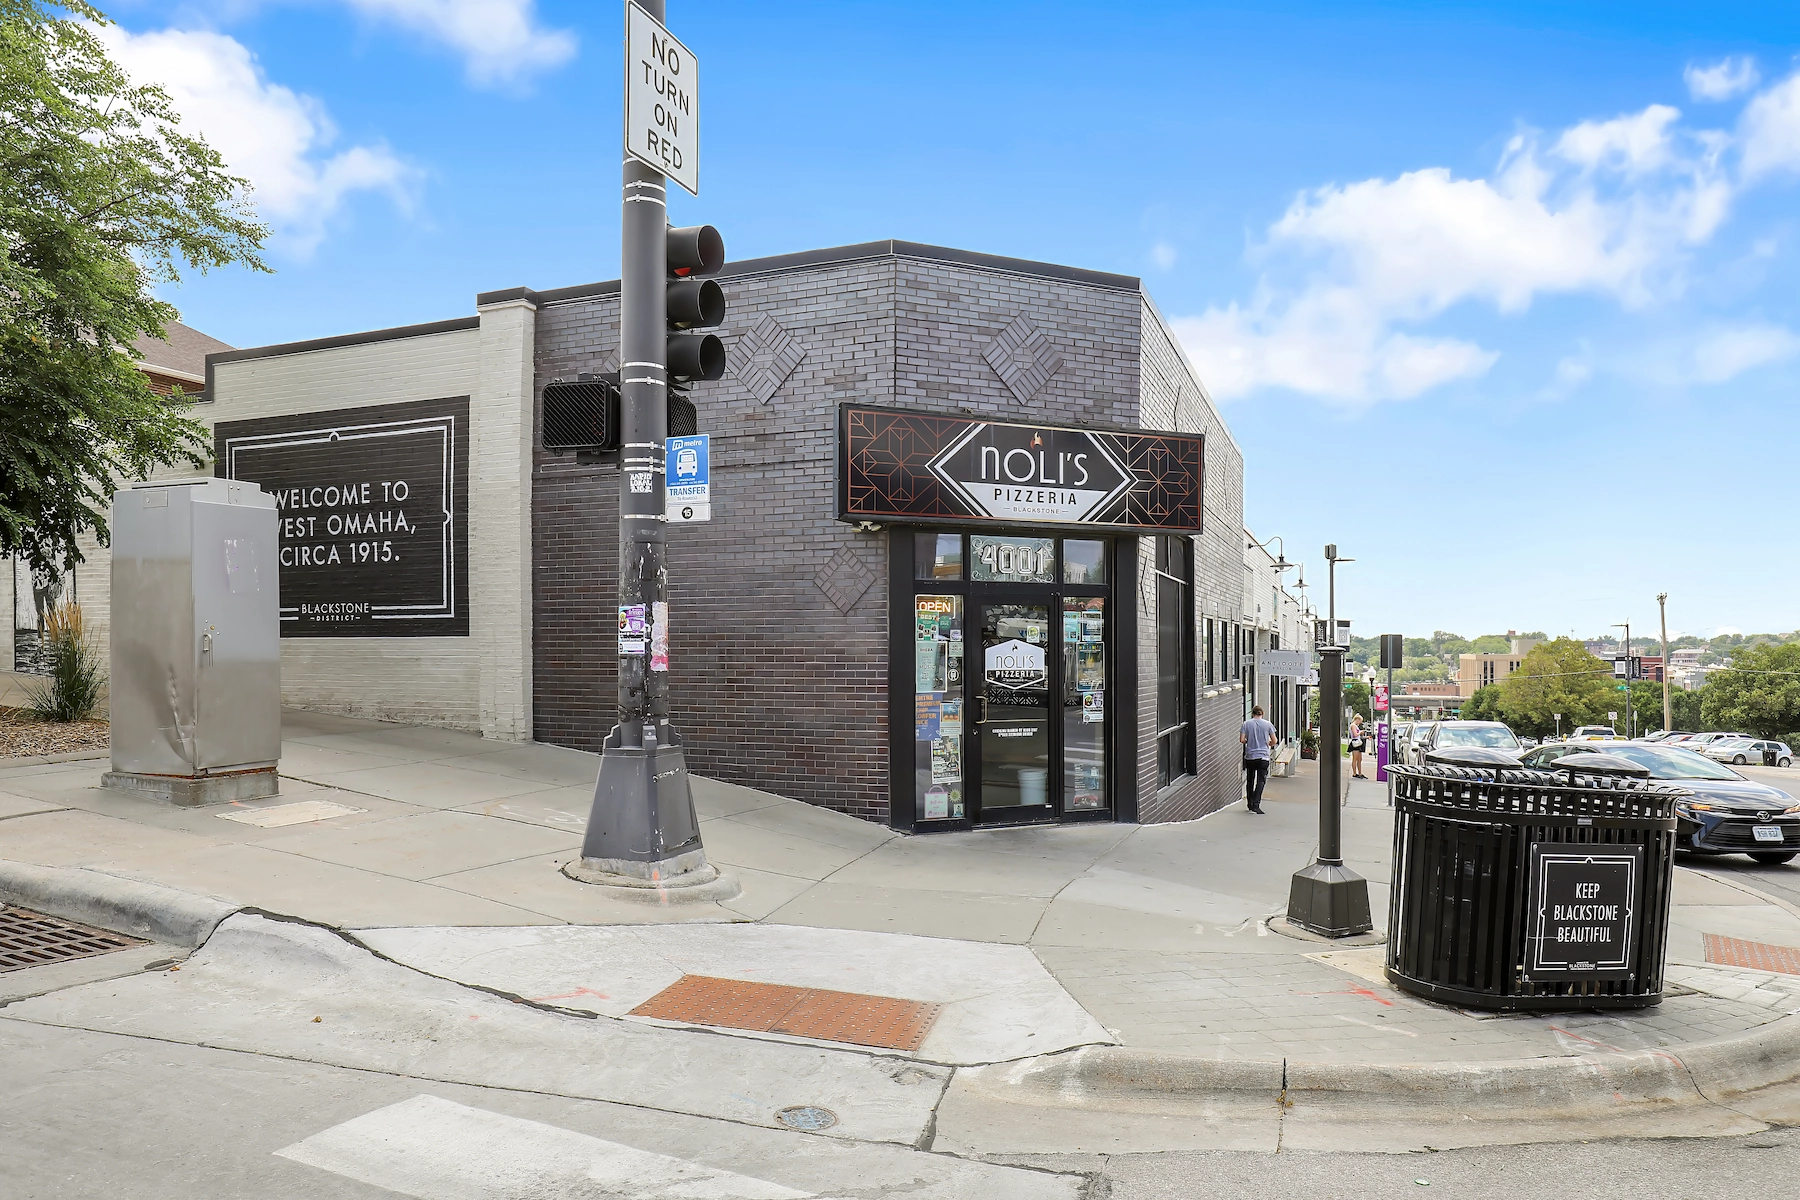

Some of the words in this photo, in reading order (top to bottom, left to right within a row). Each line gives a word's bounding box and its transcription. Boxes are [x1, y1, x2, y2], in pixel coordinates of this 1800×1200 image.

[651, 31, 680, 76] NO
[641, 59, 689, 116] TURN
[654, 103, 677, 138] ON
[647, 128, 682, 170] RED
[269, 482, 371, 509] WELCOME
[381, 480, 409, 503] TO
[669, 486, 706, 496] TRANSFER
[994, 488, 1077, 505] PIZZERIA
[683, 509, 691, 517] 15
[1013, 506, 1060, 514] BLACKSTONE
[327, 510, 416, 535] OMAHA,
[279, 544, 341, 567] CIRCA
[349, 541, 400, 563] 1915.
[981, 544, 1046, 575] 4001
[301, 603, 369, 614] BLACKSTONE
[919, 601, 951, 613] OPEN
[995, 655, 1035, 669] NOLI'S
[995, 670, 1035, 678] PIZZERIA
[1575, 882, 1600, 899] KEEP
[1553, 904, 1618, 921] BLACKSTONE
[1557, 926, 1611, 943] BEAUTIFUL
